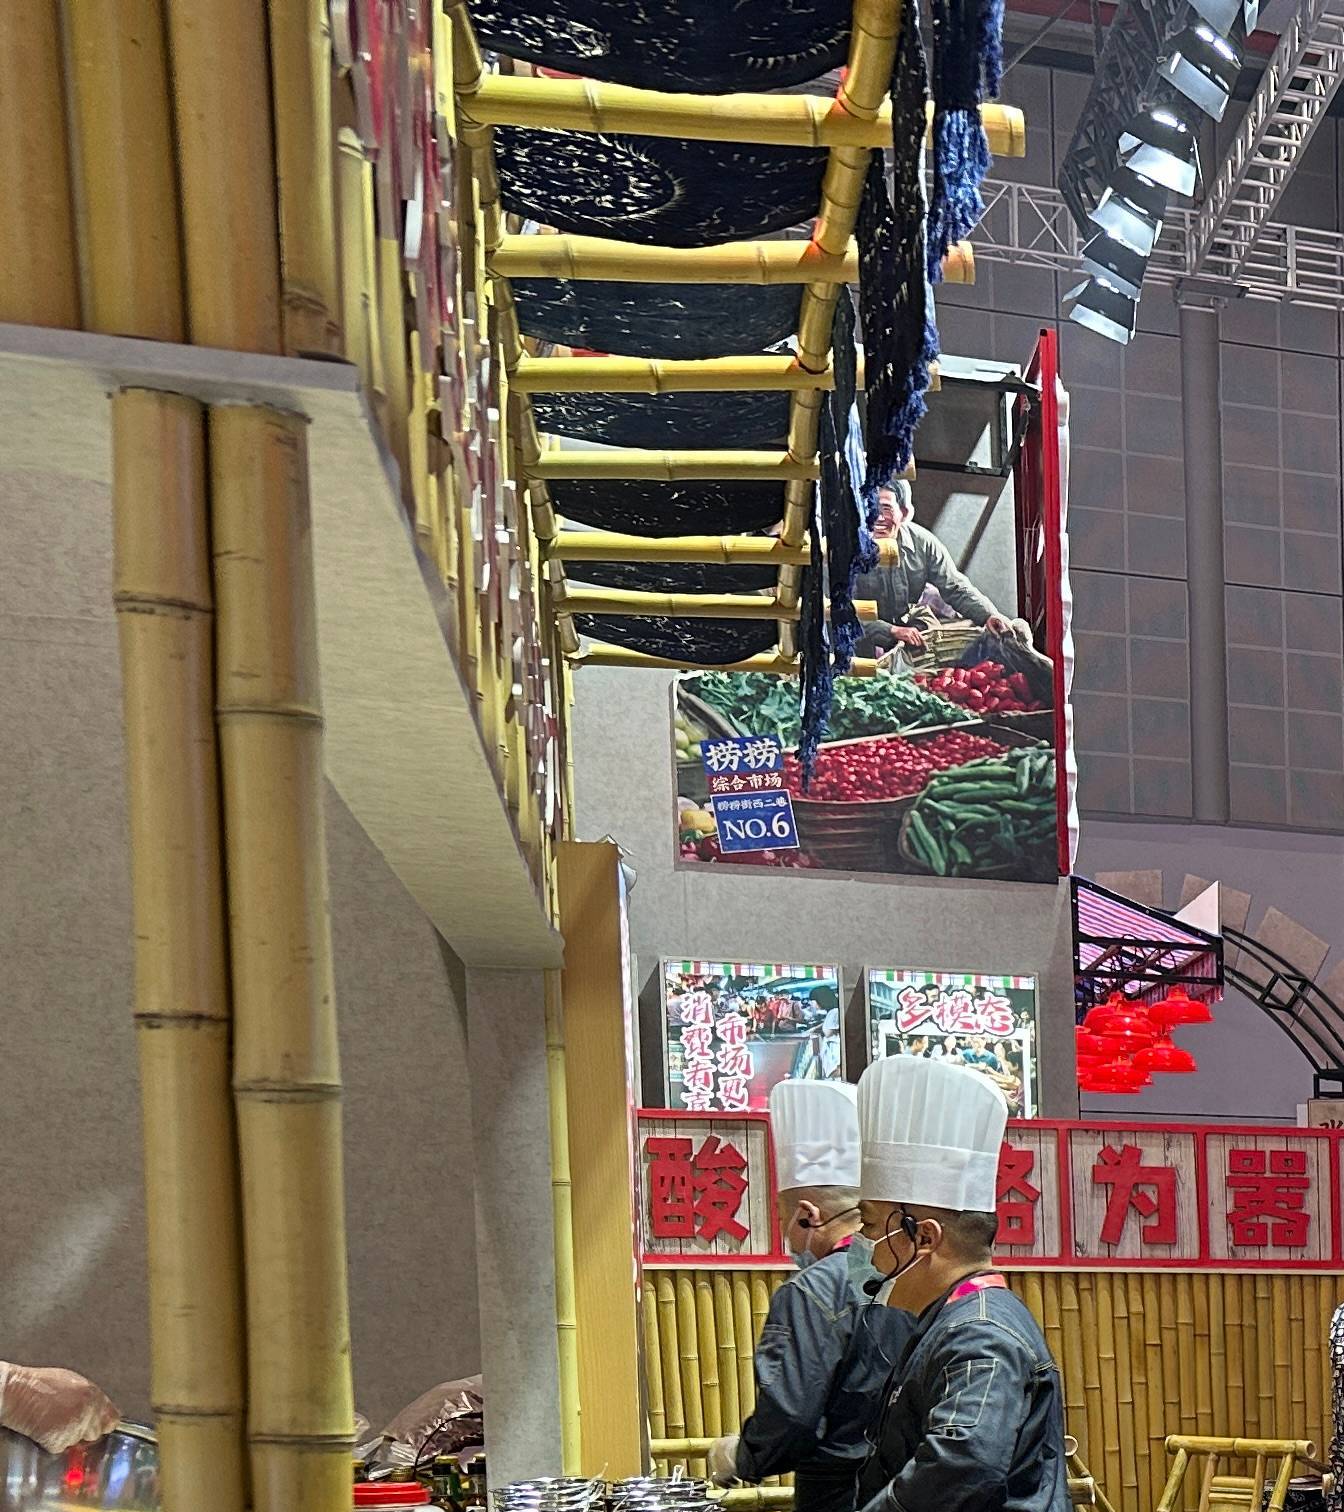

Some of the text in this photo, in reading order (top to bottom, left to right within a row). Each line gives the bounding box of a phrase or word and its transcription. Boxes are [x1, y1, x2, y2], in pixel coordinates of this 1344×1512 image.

[706, 738, 780, 772] 捞捞
[712, 773, 782, 792] 综合市场
[722, 811, 791, 841] NO.6
[896, 985, 1015, 1036] 多模态
